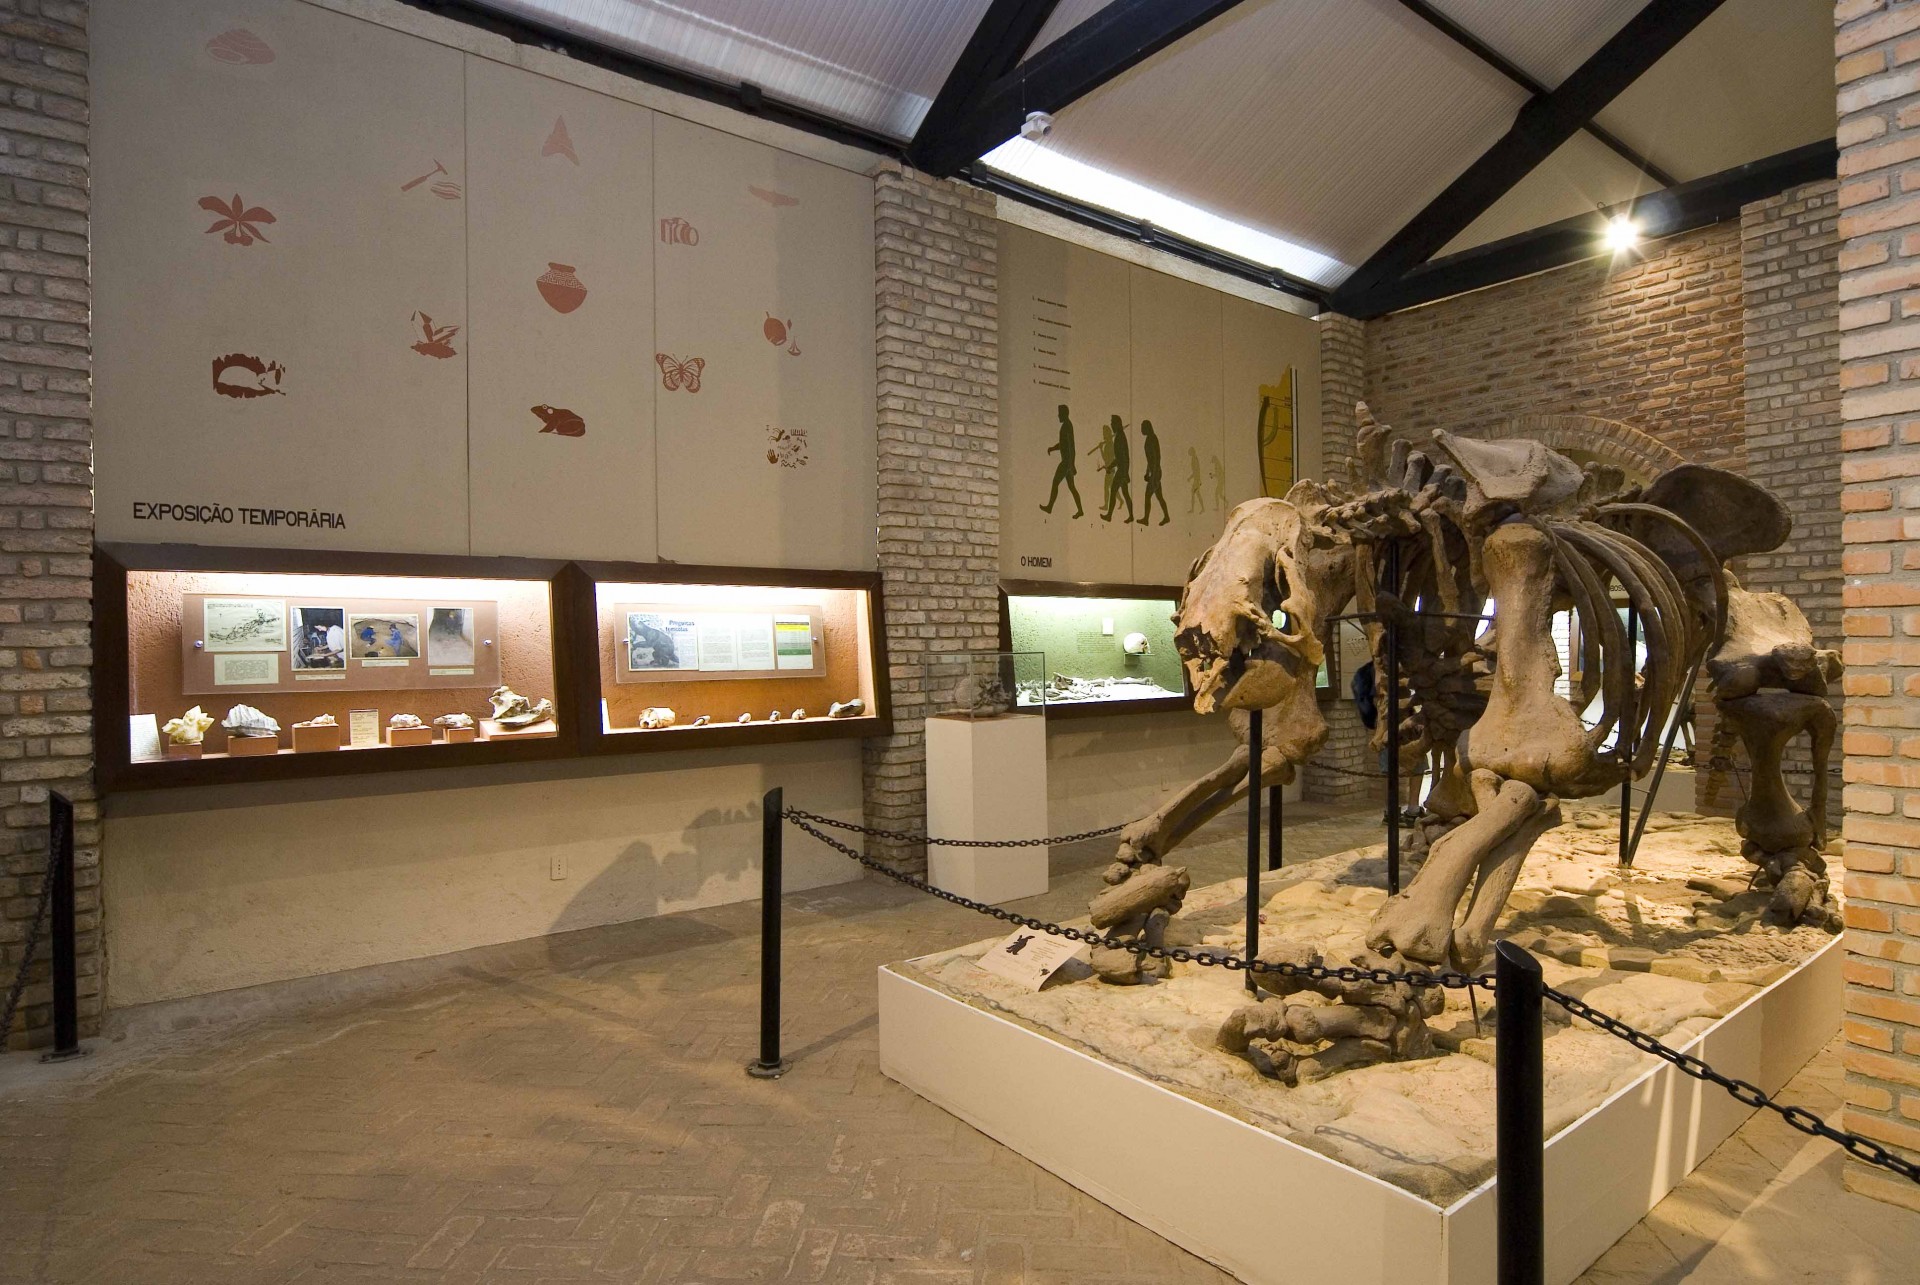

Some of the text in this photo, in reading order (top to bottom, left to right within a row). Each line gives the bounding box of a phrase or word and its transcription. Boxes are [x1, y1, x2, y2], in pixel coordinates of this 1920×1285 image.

[133, 502, 234, 524] EXPOSIÇÃO
[1020, 555, 1052, 568] O HOMEM
